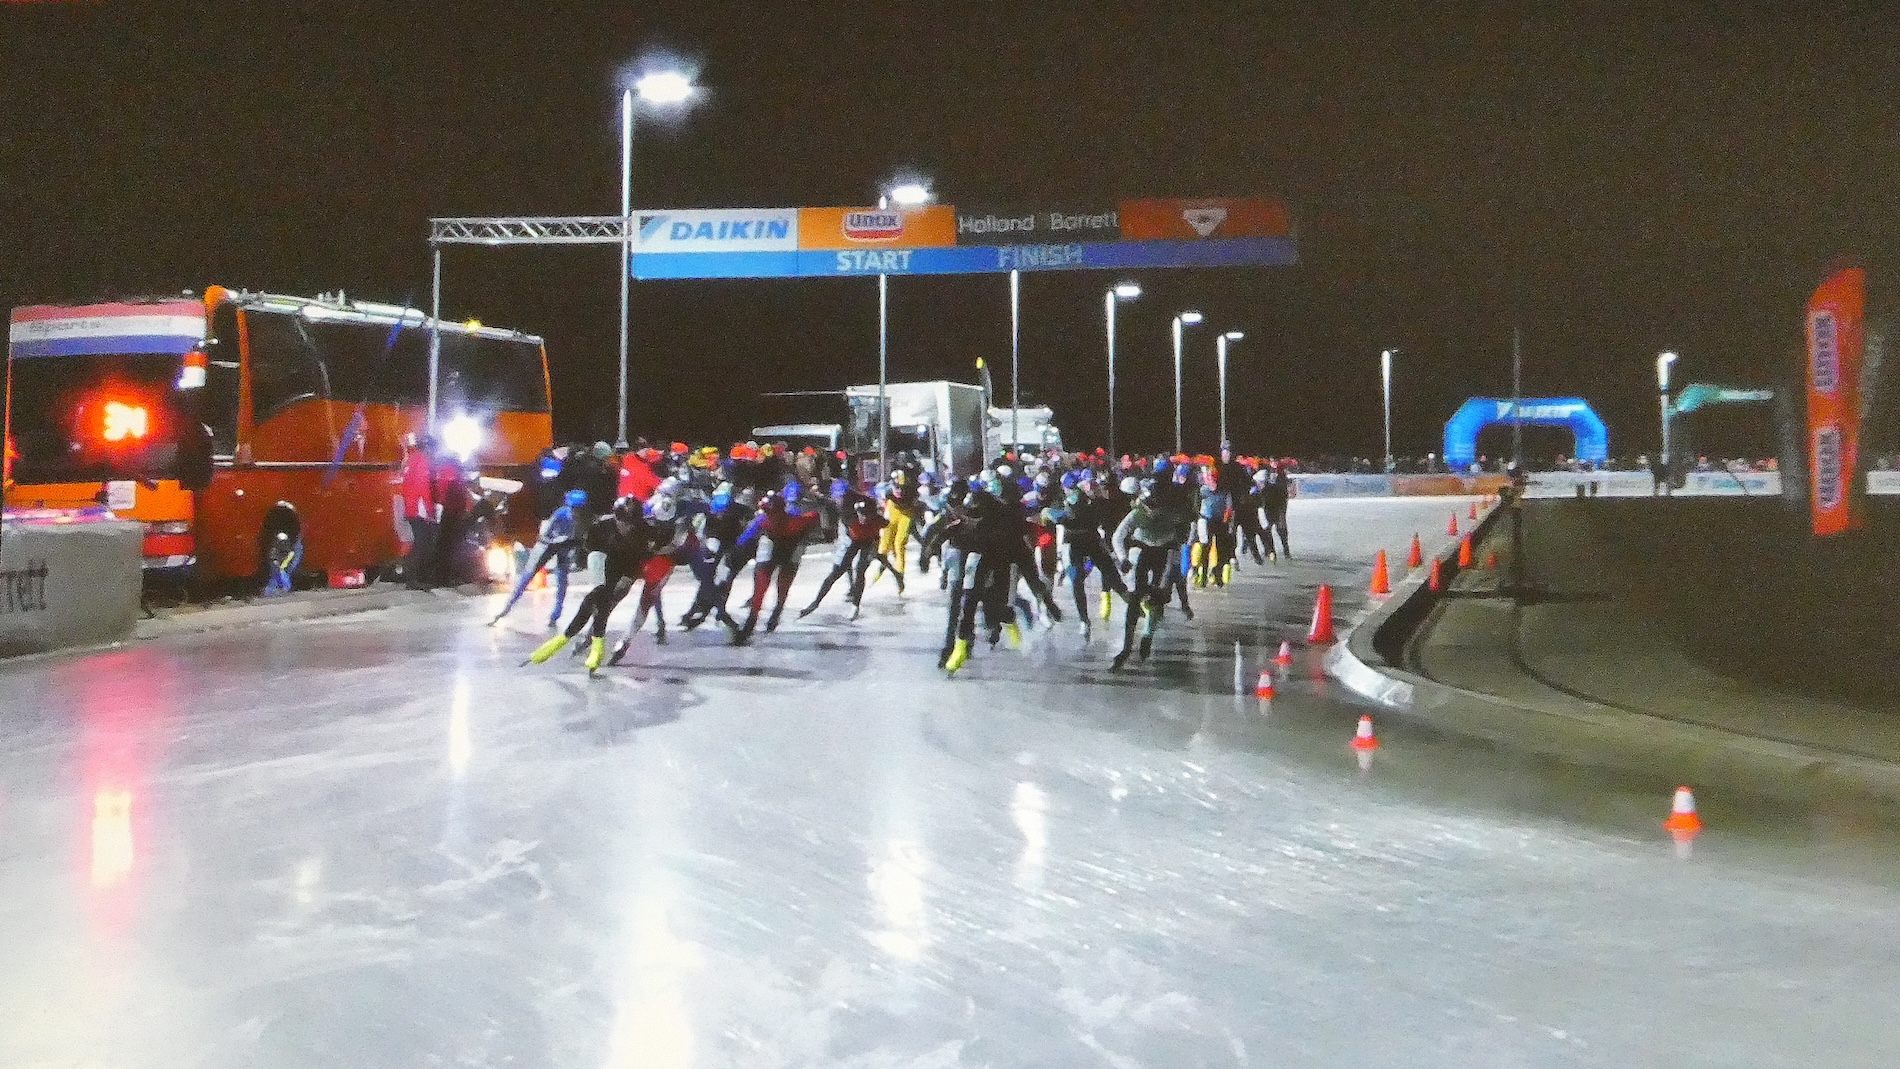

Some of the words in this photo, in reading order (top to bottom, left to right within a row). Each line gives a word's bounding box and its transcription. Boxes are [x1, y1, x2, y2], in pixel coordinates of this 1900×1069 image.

[669, 219, 790, 241] DAIKIN
[957, 214, 1036, 234] Holland
[1050, 211, 1119, 231] Barrett
[836, 249, 912, 271] START
[997, 244, 1084, 268] FINISH
